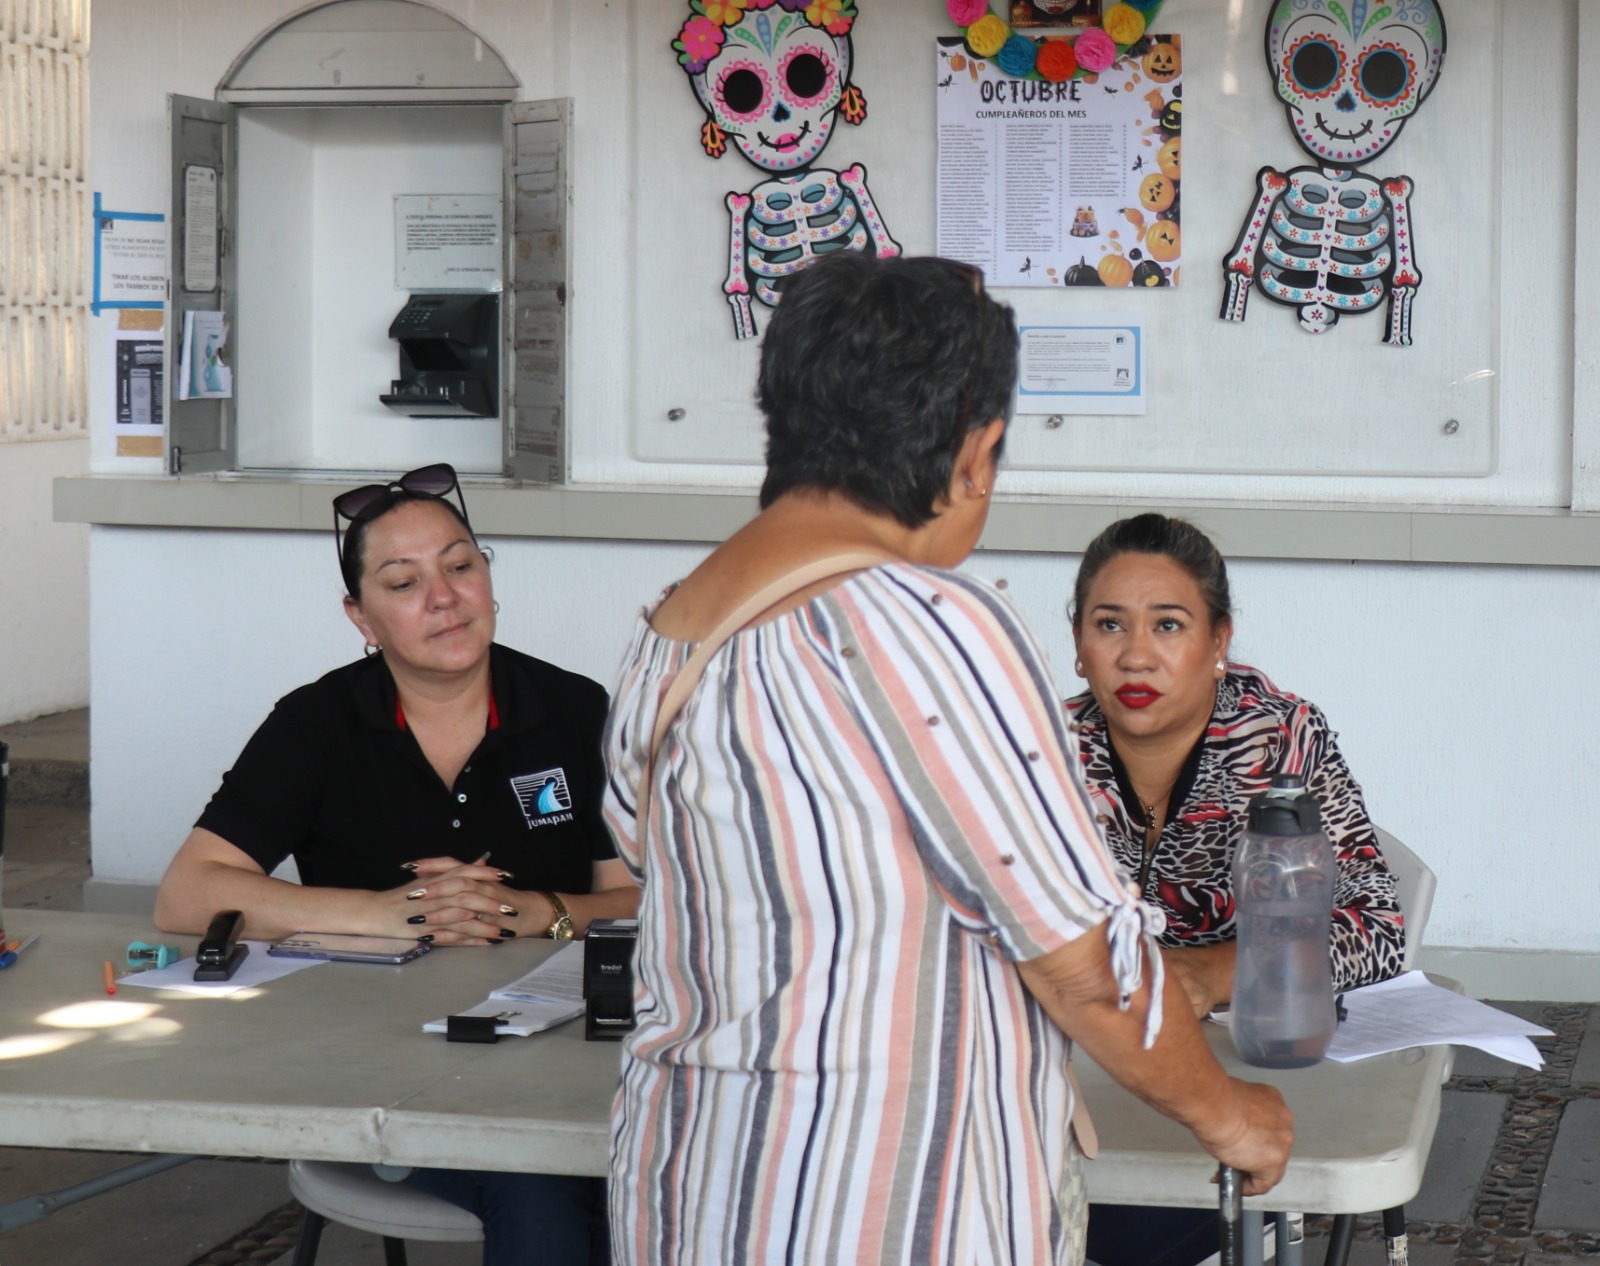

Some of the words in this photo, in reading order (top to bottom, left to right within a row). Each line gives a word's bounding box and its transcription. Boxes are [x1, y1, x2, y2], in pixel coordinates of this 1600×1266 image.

[980, 80, 1082, 104] OCTUBRE
[975, 109, 1047, 119] CUMPLEAÑEROS
[1049, 110, 1066, 119] DEL
[1067, 110, 1087, 119] MES
